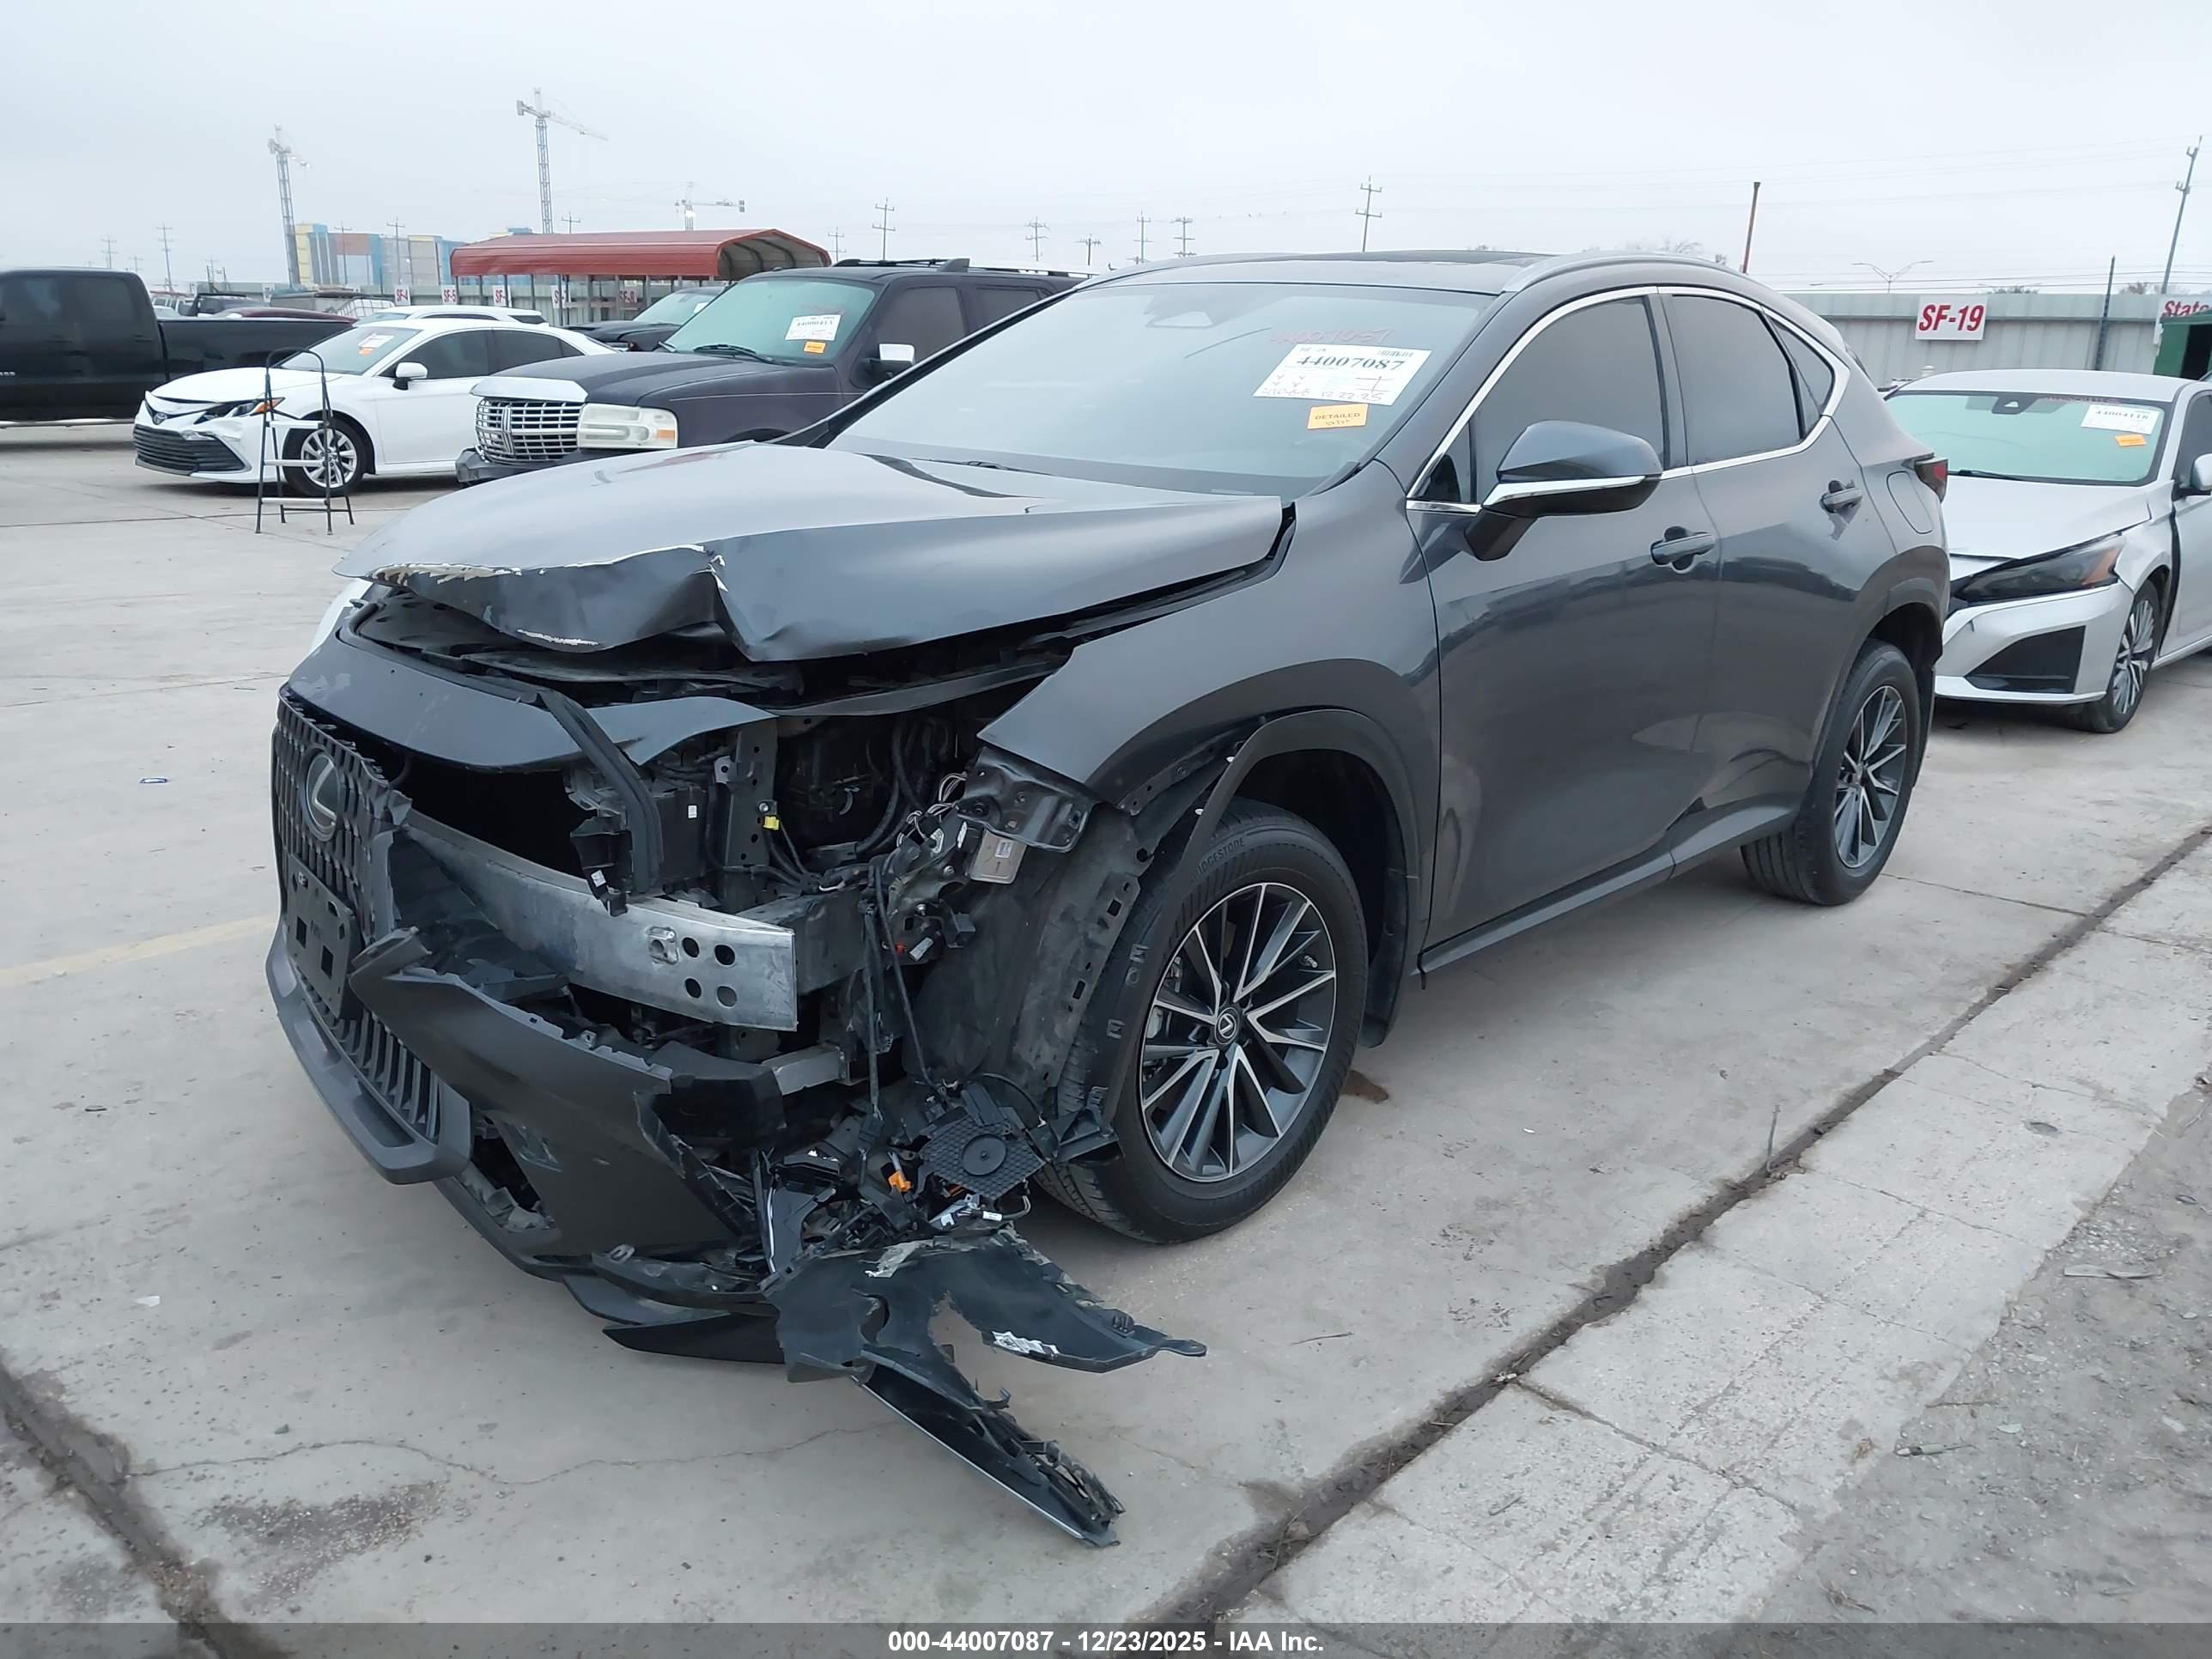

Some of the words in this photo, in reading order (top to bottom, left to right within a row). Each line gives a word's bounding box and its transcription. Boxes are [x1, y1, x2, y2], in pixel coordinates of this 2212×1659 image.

[443, 289, 457, 303] SF-5
[495, 289, 509, 303] SF-
[1918, 304, 1984, 331] SF-19
[1296, 356, 1406, 371] 44007087
[1193, 837, 1244, 879] IDGESTONE
